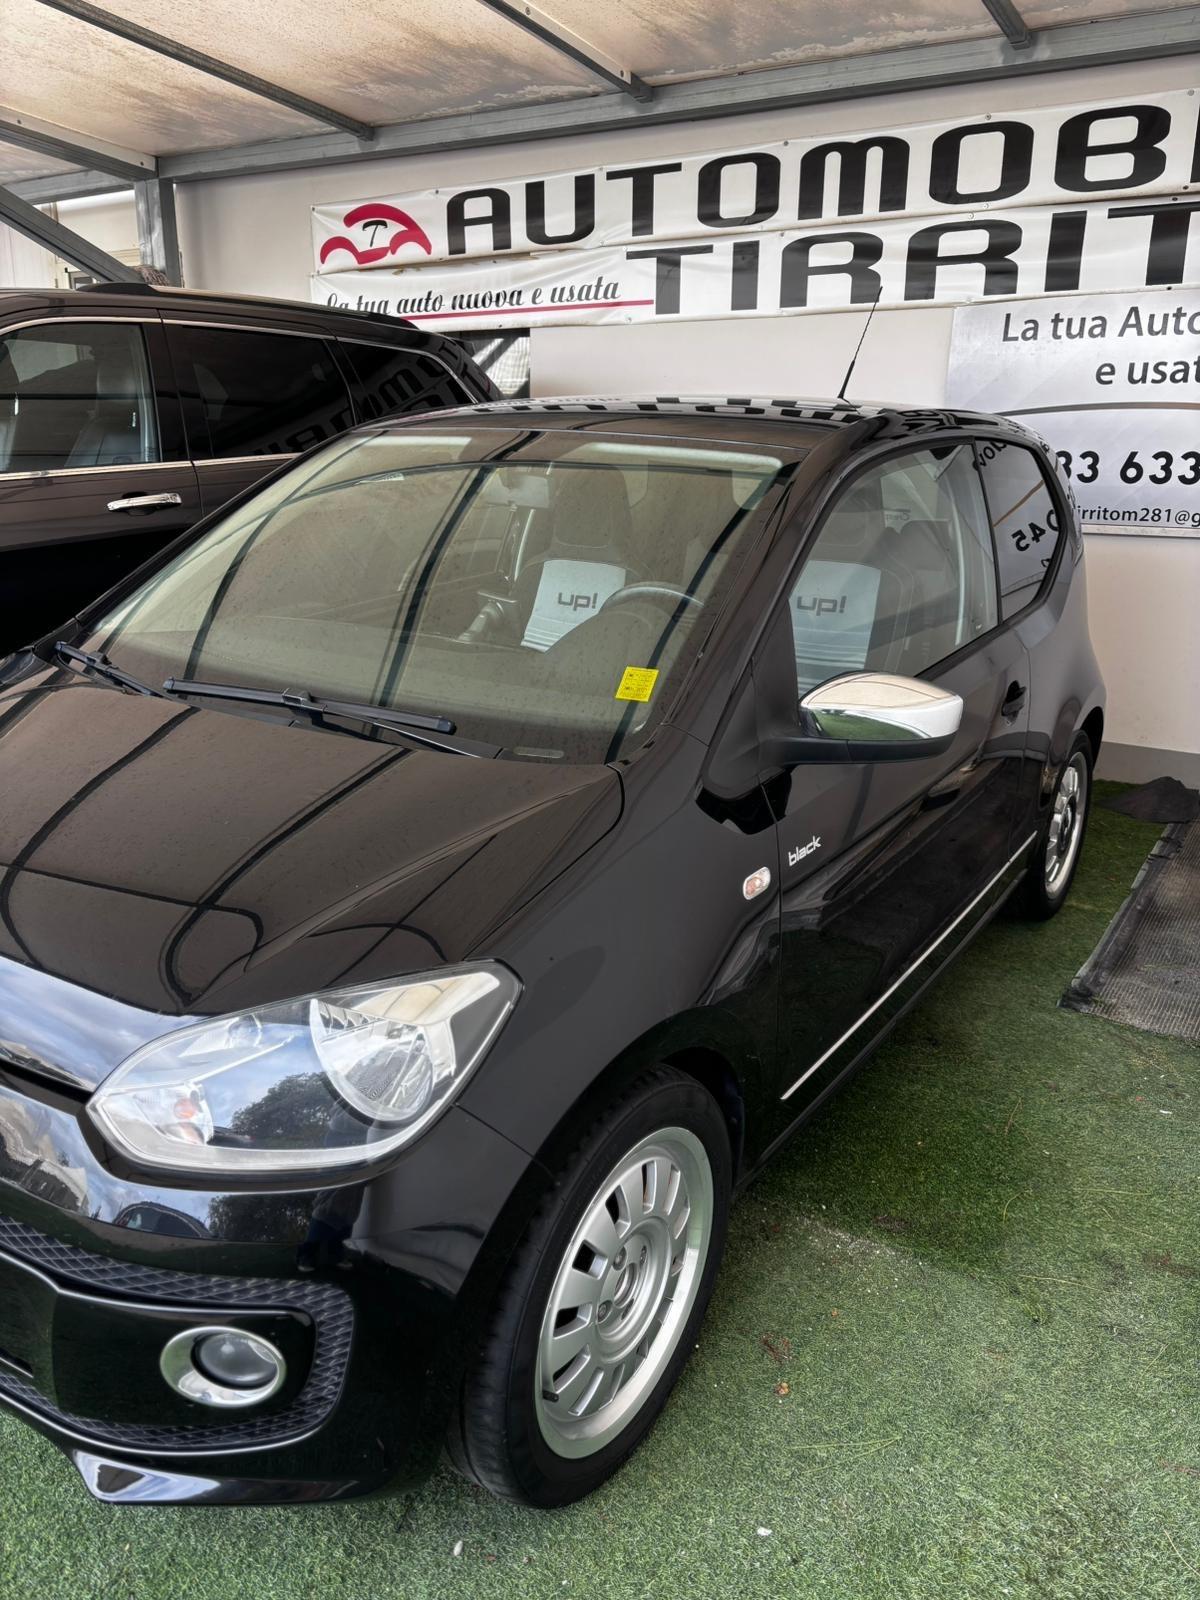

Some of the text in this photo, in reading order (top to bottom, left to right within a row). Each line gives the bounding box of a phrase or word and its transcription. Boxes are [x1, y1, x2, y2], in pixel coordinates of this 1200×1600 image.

[626, 200, 1200, 315] TIRRIT
[396, 290, 445, 314] auto
[451, 288, 525, 310] nuova
[531, 288, 543, 305] e
[550, 276, 621, 304] usata
[1002, 306, 1200, 342] La tua Auto
[1096, 362, 1116, 385] e
[1119, 451, 1200, 485] 633
[558, 592, 598, 610] up!
[797, 595, 847, 616] up!
[788, 835, 821, 867] black
